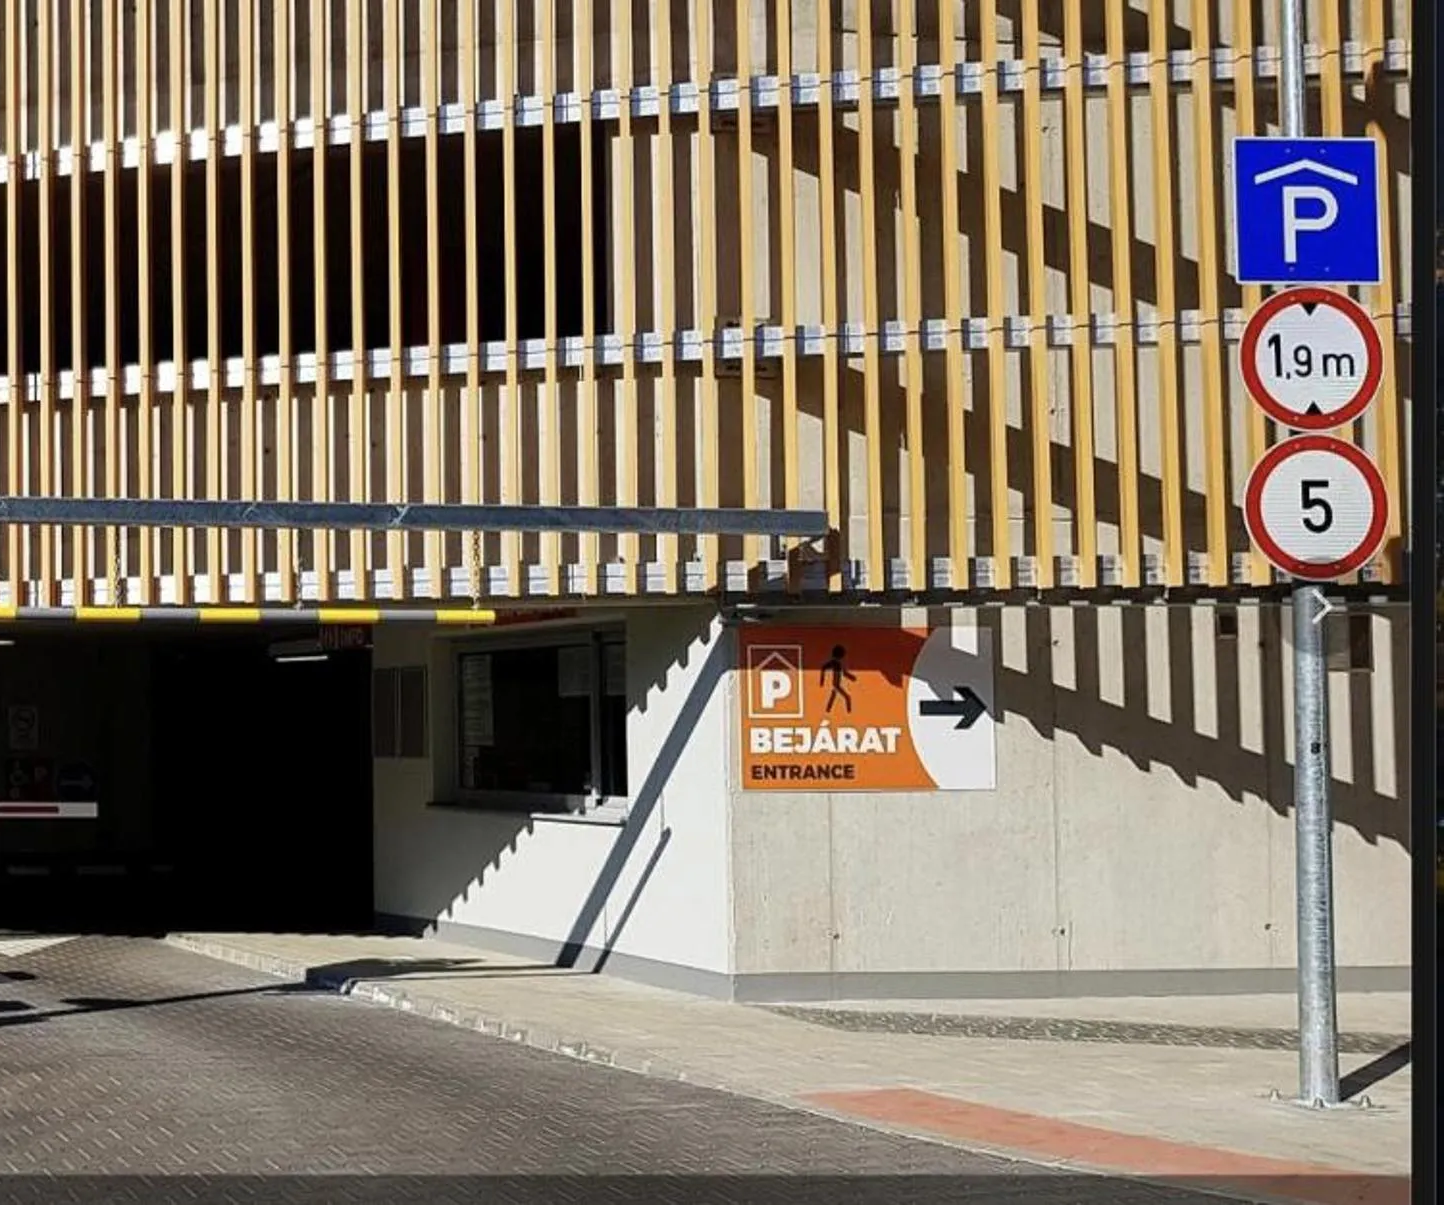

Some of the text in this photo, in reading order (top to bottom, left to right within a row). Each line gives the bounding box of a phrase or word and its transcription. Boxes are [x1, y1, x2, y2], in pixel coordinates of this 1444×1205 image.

[1281, 185, 1339, 264] P
[1322, 353, 1354, 377] m
[1301, 480, 1334, 534] 5
[760, 671, 792, 709] P
[749, 720, 901, 754] BEJÁRAT
[751, 764, 855, 781] ENTRANCE
